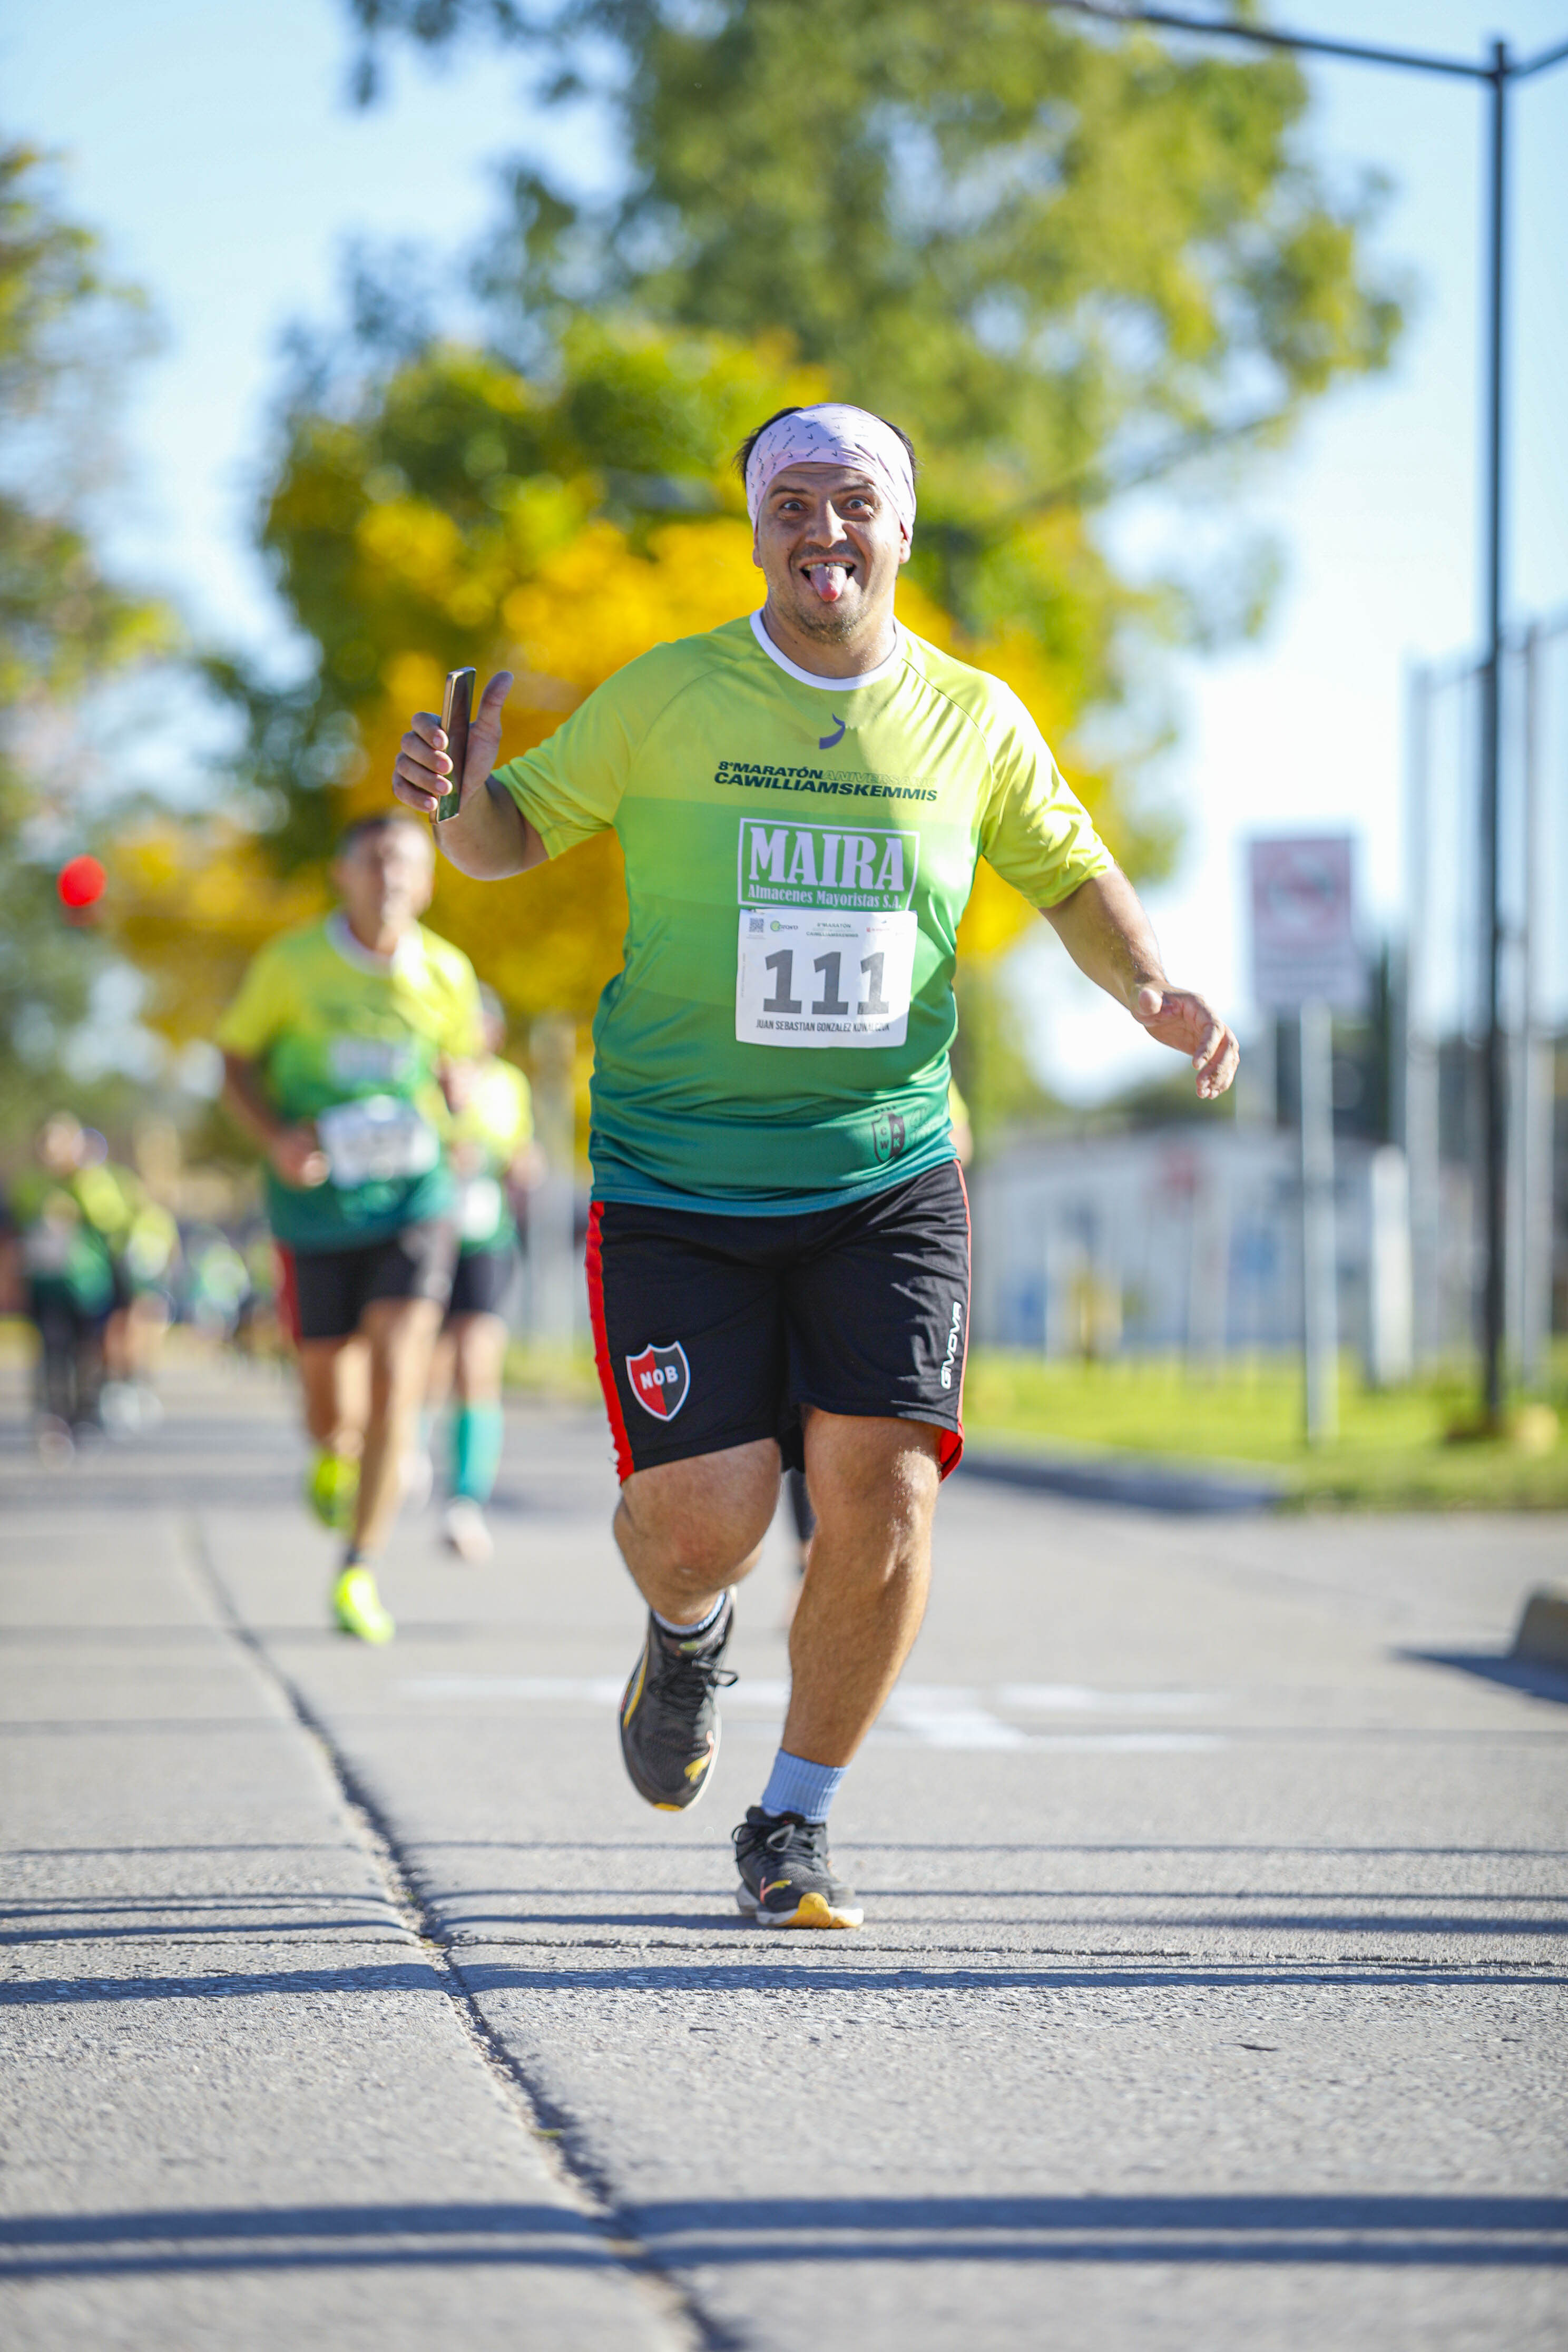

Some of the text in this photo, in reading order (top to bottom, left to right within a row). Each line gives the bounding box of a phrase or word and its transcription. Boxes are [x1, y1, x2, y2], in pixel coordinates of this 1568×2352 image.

[714, 772, 938, 801] CAWILLIAMSKEMMIS
[748, 827, 905, 891] MAIRA
[748, 884, 901, 909] Almacenes Mayoristas S.A.
[763, 949, 889, 1015] 111
[756, 1019, 774, 1029] JUAN
[775, 1021, 815, 1031] SEBASTIAN
[817, 1022, 851, 1032] GONZALEZ
[940, 1301, 962, 1389] GIVOVA
[640, 1365, 679, 1390] NOB
